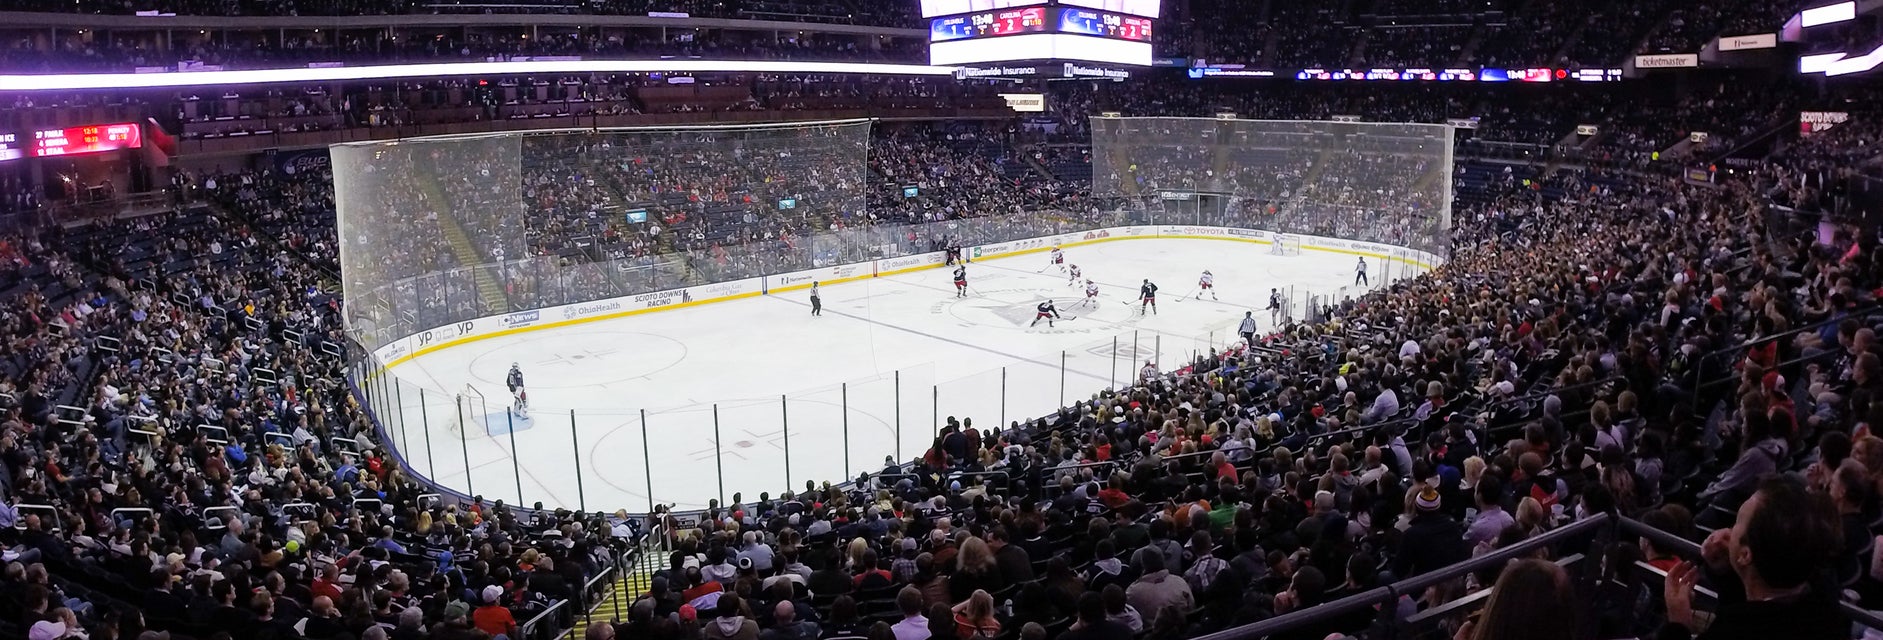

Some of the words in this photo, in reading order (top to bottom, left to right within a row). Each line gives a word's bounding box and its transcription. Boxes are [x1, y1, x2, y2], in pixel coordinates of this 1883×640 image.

[1007, 19, 1014, 31] 2
[1642, 57, 1686, 66] ticketmaster
[965, 67, 1002, 77] Nationwide
[1003, 66, 1035, 75] Insurance
[1073, 67, 1104, 77] Nationwide
[1105, 68, 1129, 78] Insurance
[891, 258, 920, 268] OhioHealth
[635, 294, 657, 303] SCIOTO
[659, 290, 682, 299] DOWNS
[578, 302, 621, 315] OhioHealth
[457, 321, 474, 335] yp
[418, 331, 432, 346] yp
